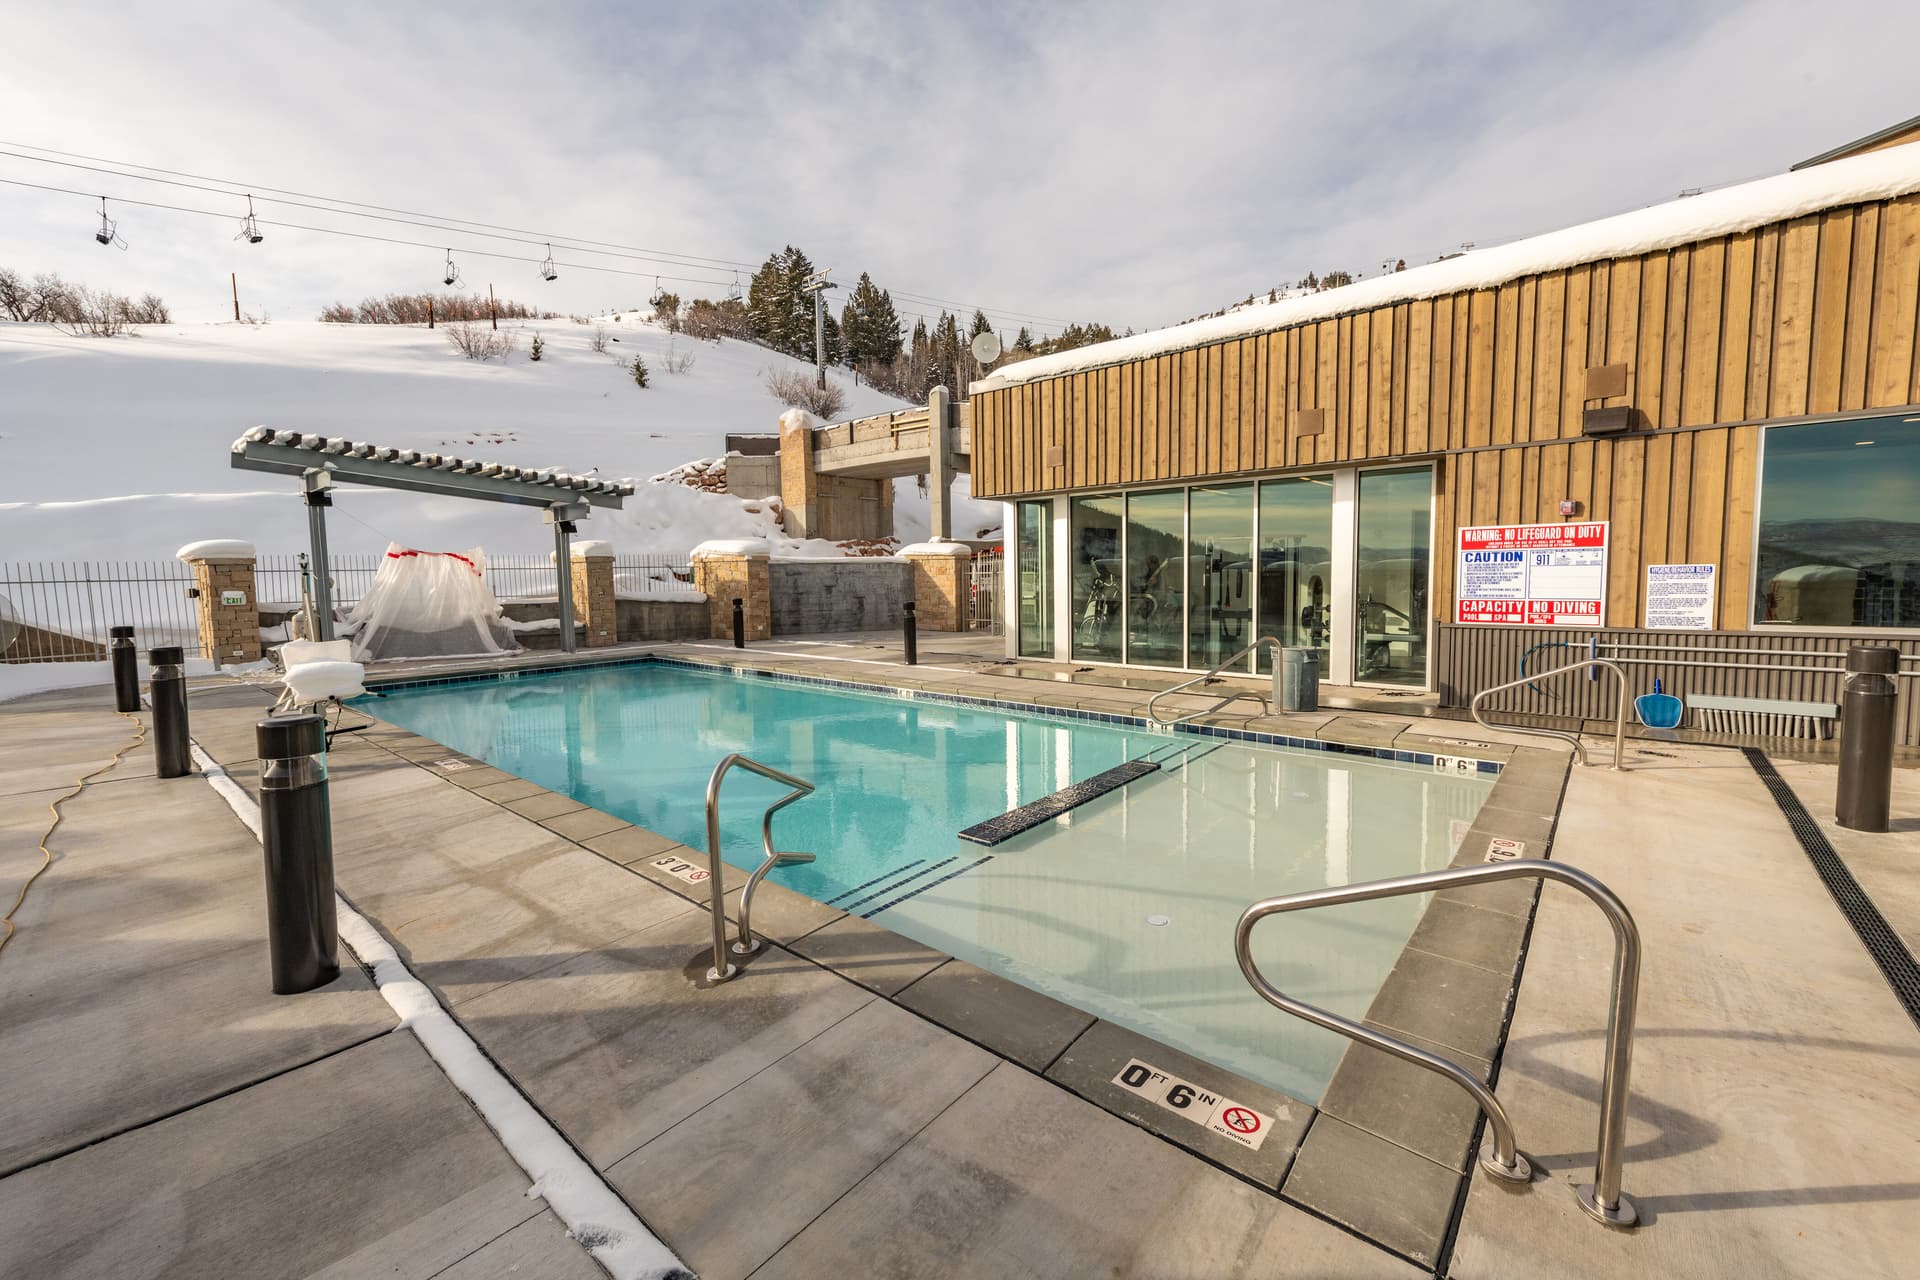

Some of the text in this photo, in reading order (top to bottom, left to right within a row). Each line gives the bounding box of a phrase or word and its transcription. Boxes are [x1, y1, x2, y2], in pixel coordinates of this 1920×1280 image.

[1465, 525, 1602, 542] WARNING: NO LIFEGUARD ON DUTY
[1465, 551, 1523, 562] CAUTION
[1536, 555, 1550, 566] 911
[1463, 601, 1523, 612] CAPACITY
[1533, 602, 1595, 613] NO DIVING
[1213, 1125, 1252, 1145] NO DIVING
